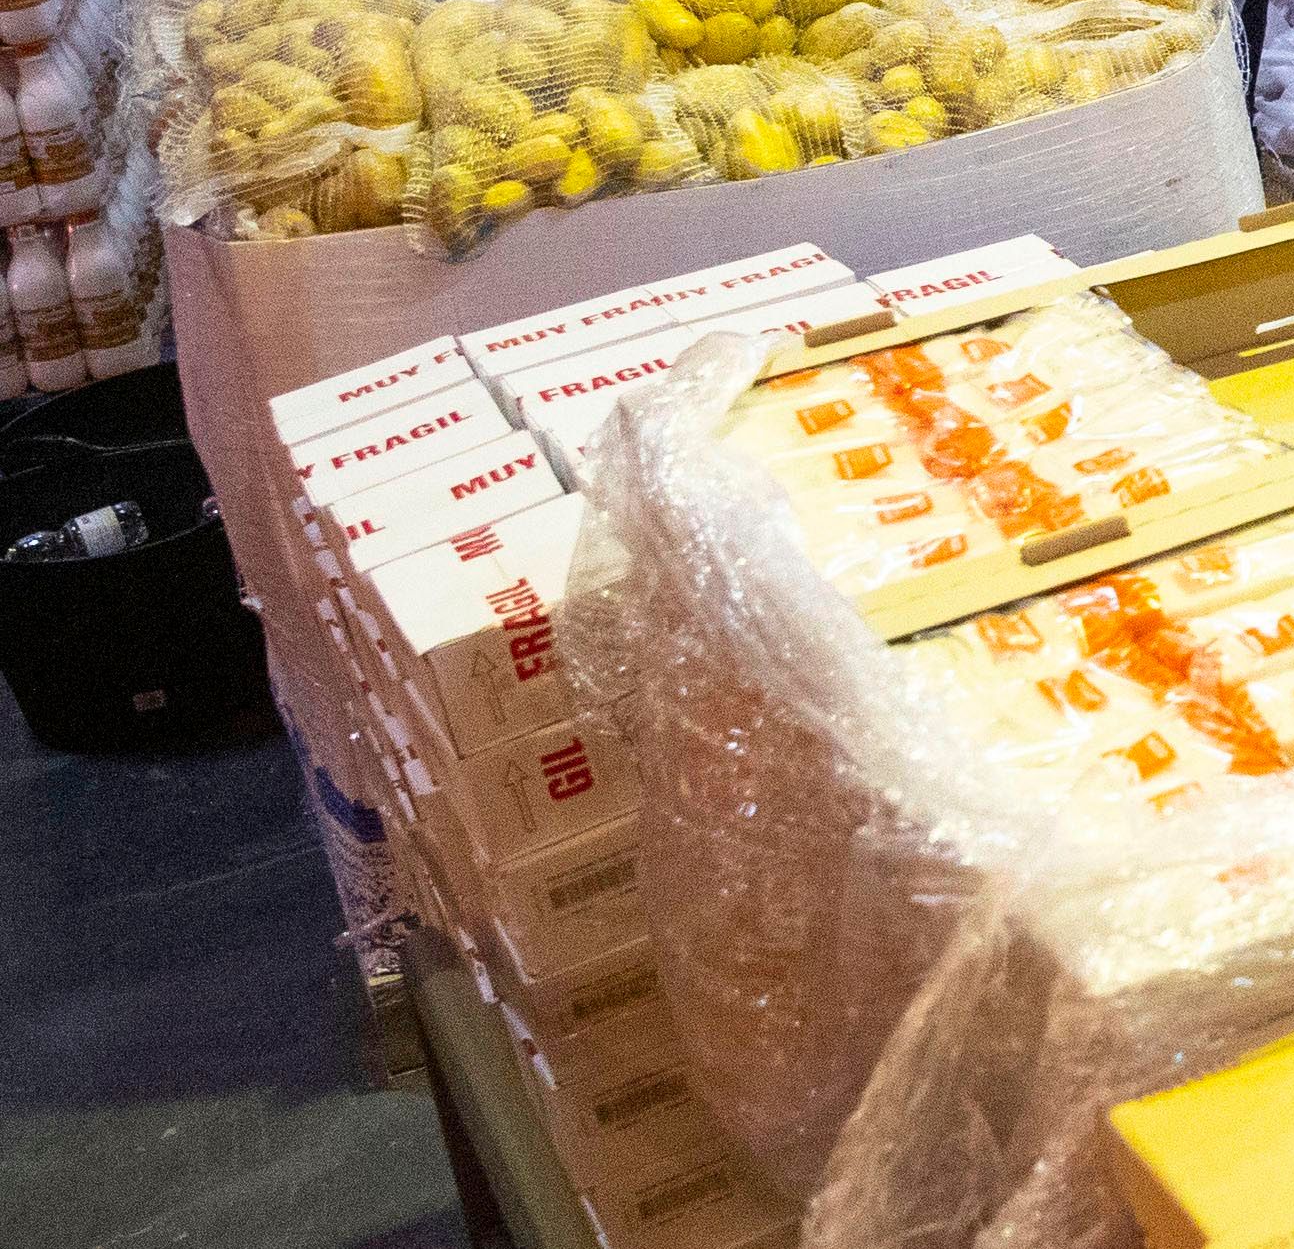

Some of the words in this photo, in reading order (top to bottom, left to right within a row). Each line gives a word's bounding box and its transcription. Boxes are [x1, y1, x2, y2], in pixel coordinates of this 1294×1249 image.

[720, 252, 827, 290] FRAGI
[485, 323, 567, 353] MUY
[580, 297, 655, 327] FRA
[338, 364, 420, 403] MUY
[538, 357, 674, 403] FRAGIL
[331, 409, 473, 471] FRAGIL
[450, 452, 536, 501] MUY
[486, 577, 563, 683] FRAGIL
